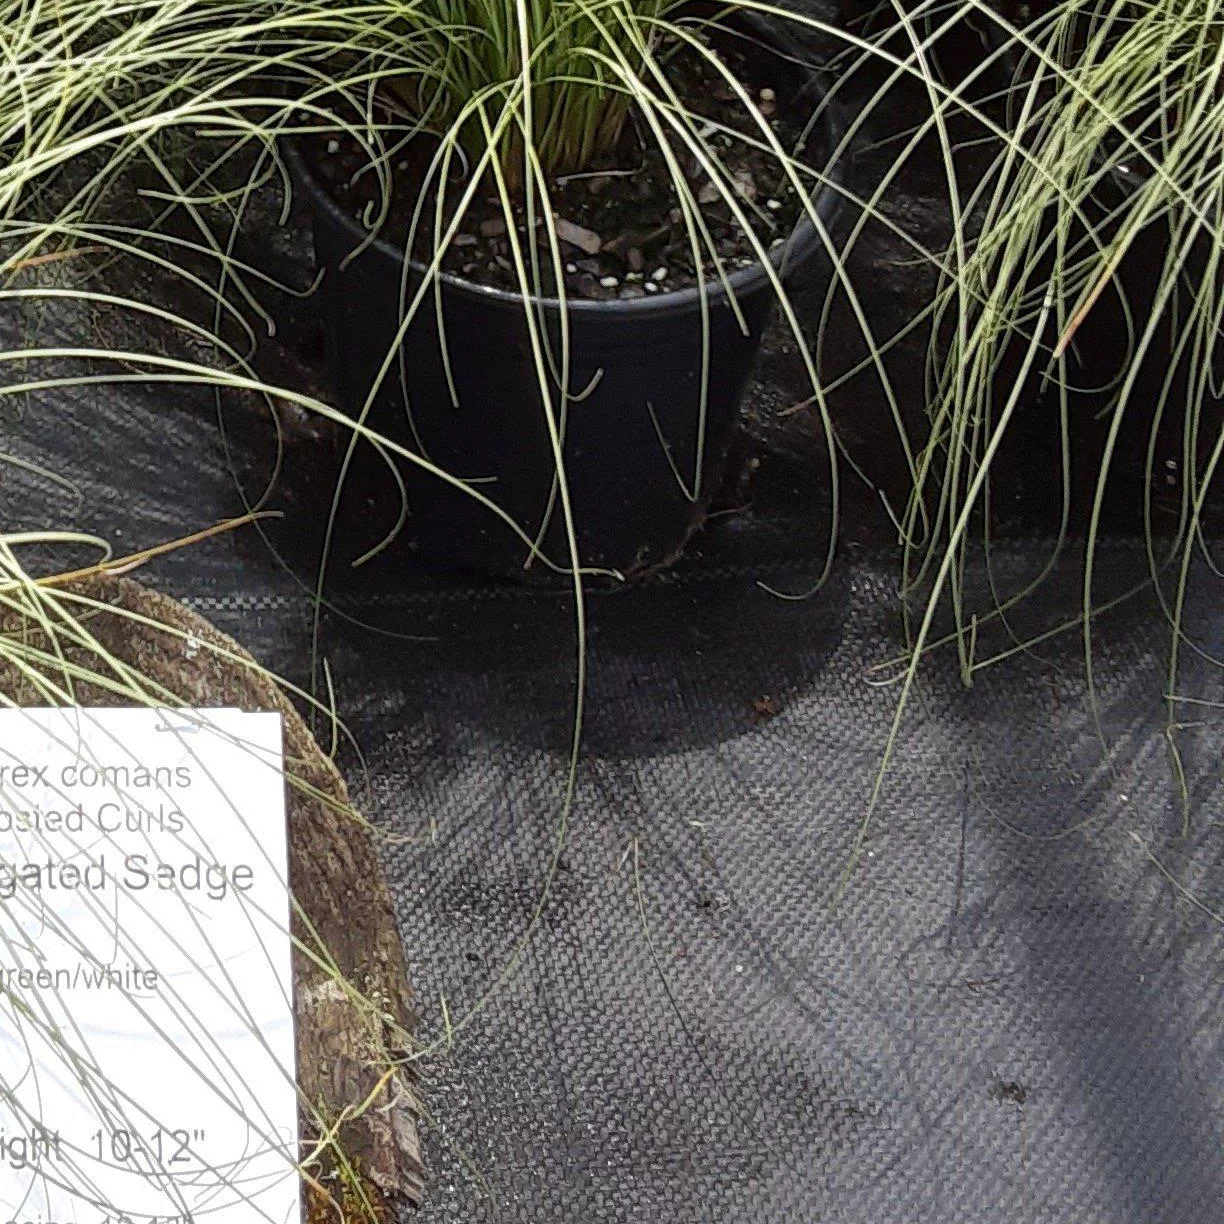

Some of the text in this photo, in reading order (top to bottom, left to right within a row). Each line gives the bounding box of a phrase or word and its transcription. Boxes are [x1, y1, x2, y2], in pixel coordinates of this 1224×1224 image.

[60, 764, 192, 788] comans
[97, 802, 184, 833] Curls
[124, 854, 255, 900] Sedge
[91, 1128, 205, 1164] 10-12"
